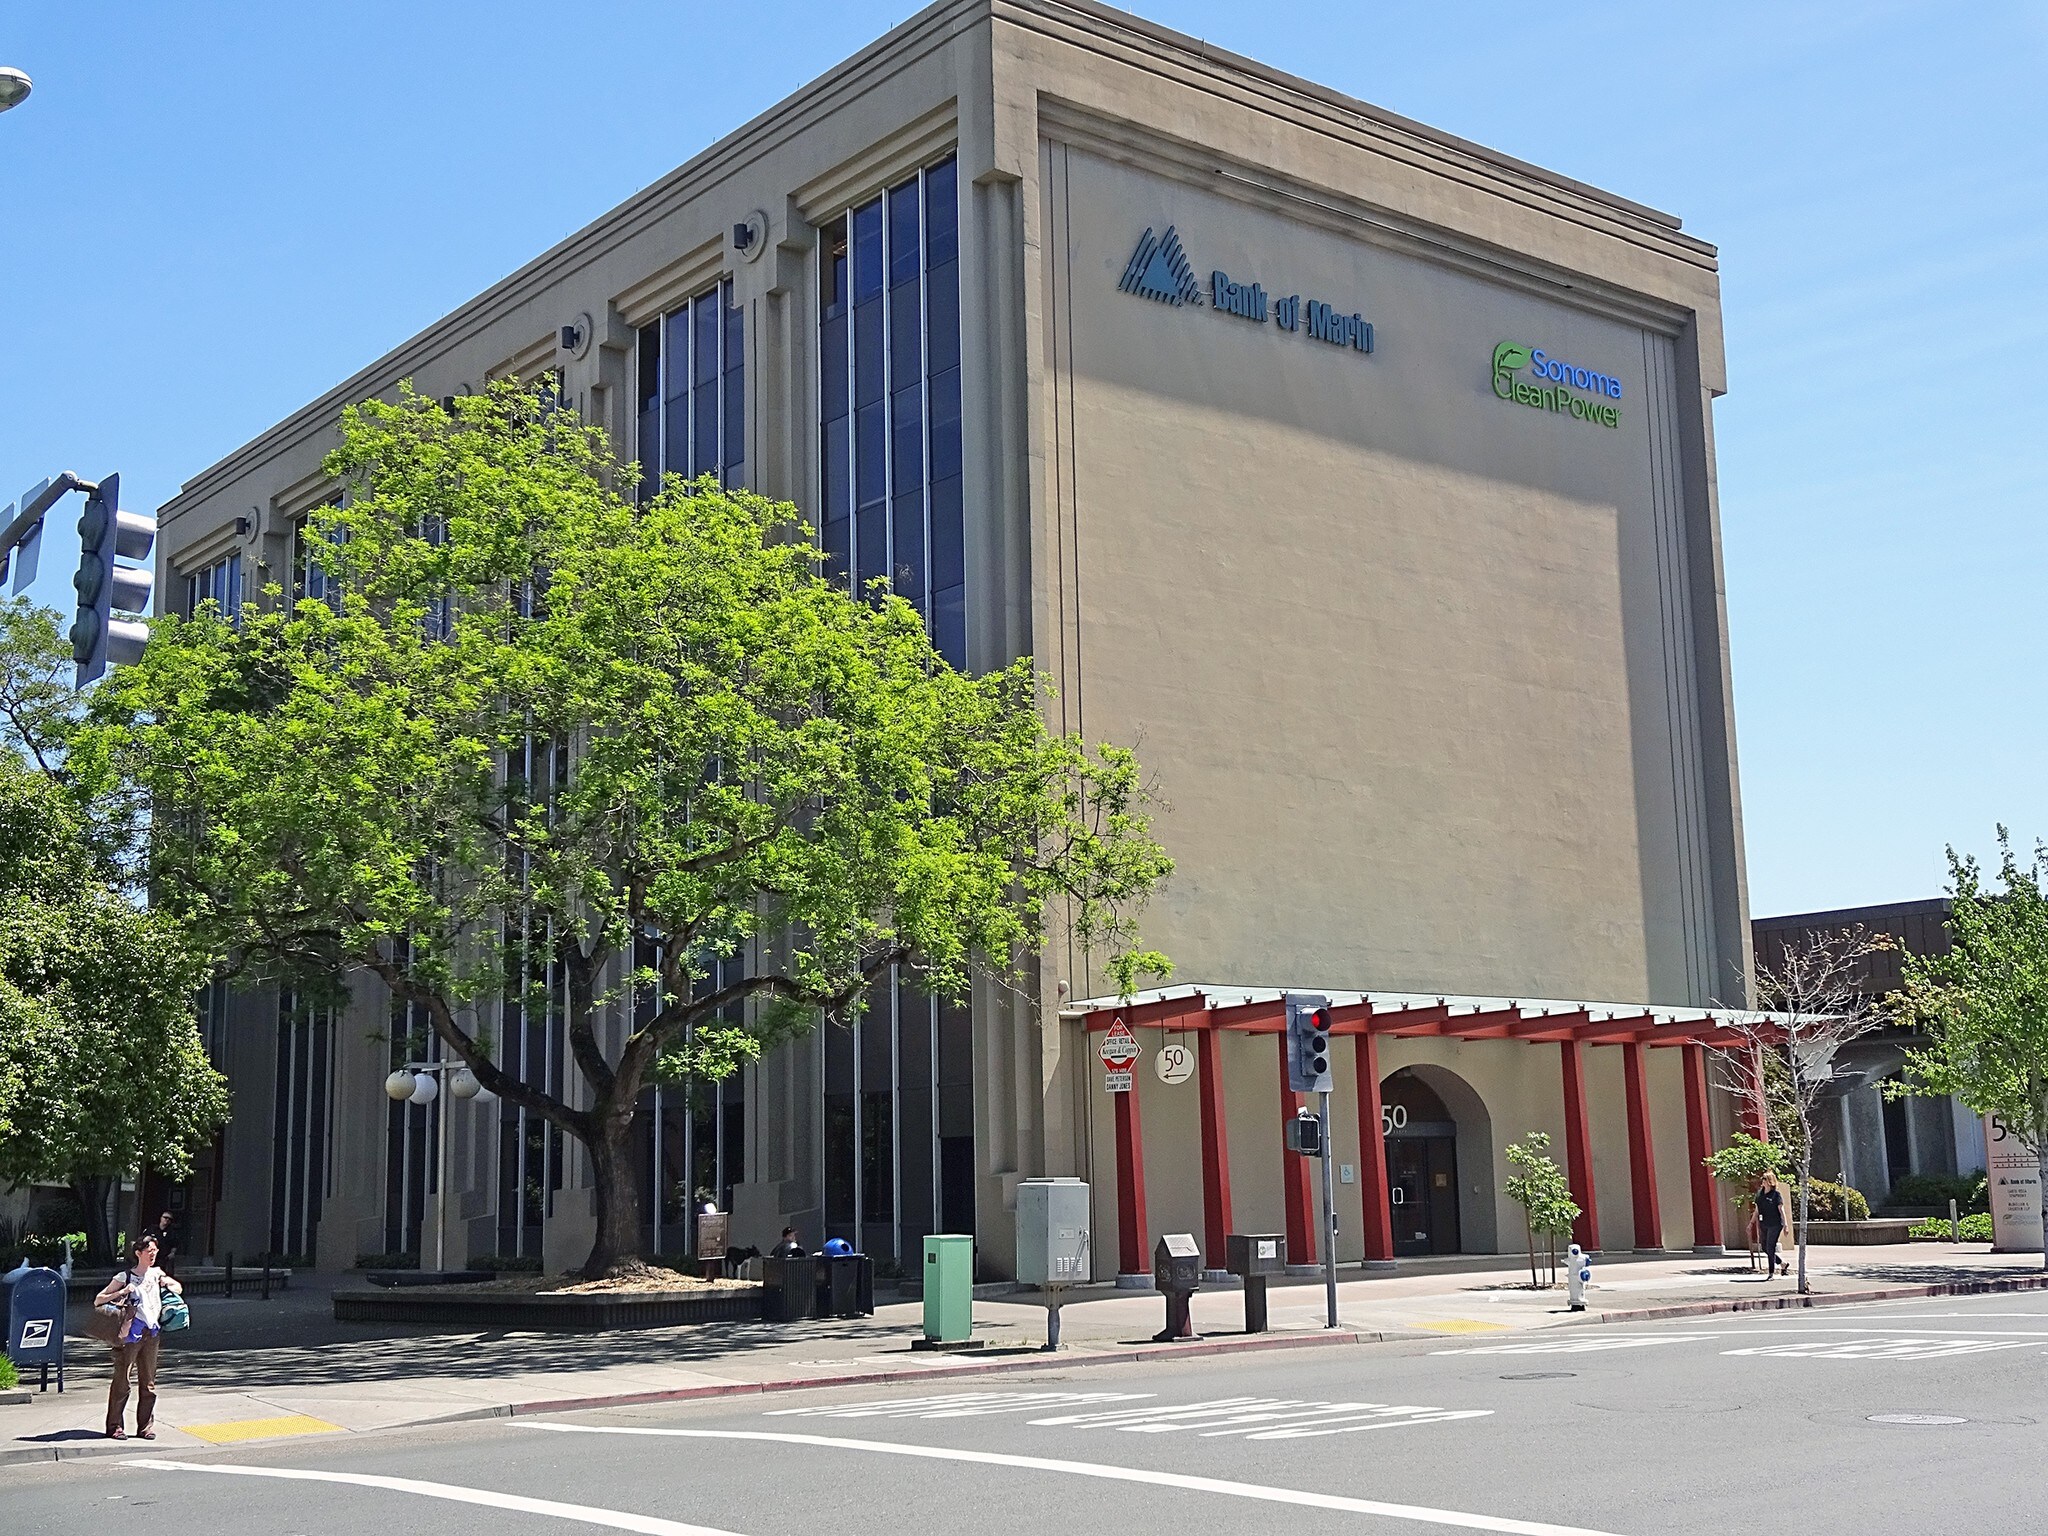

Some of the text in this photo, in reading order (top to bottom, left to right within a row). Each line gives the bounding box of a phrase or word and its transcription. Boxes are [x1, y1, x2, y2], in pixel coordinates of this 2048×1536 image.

[1213, 270, 1374, 353] Bank of Marin
[1531, 349, 1622, 399] Sonoma
[1492, 369, 1622, 428] CleanPower
[1165, 1049, 1183, 1072] 50
[1119, 1082, 1131, 1090] JONES
[1381, 1105, 1407, 1136] 50
